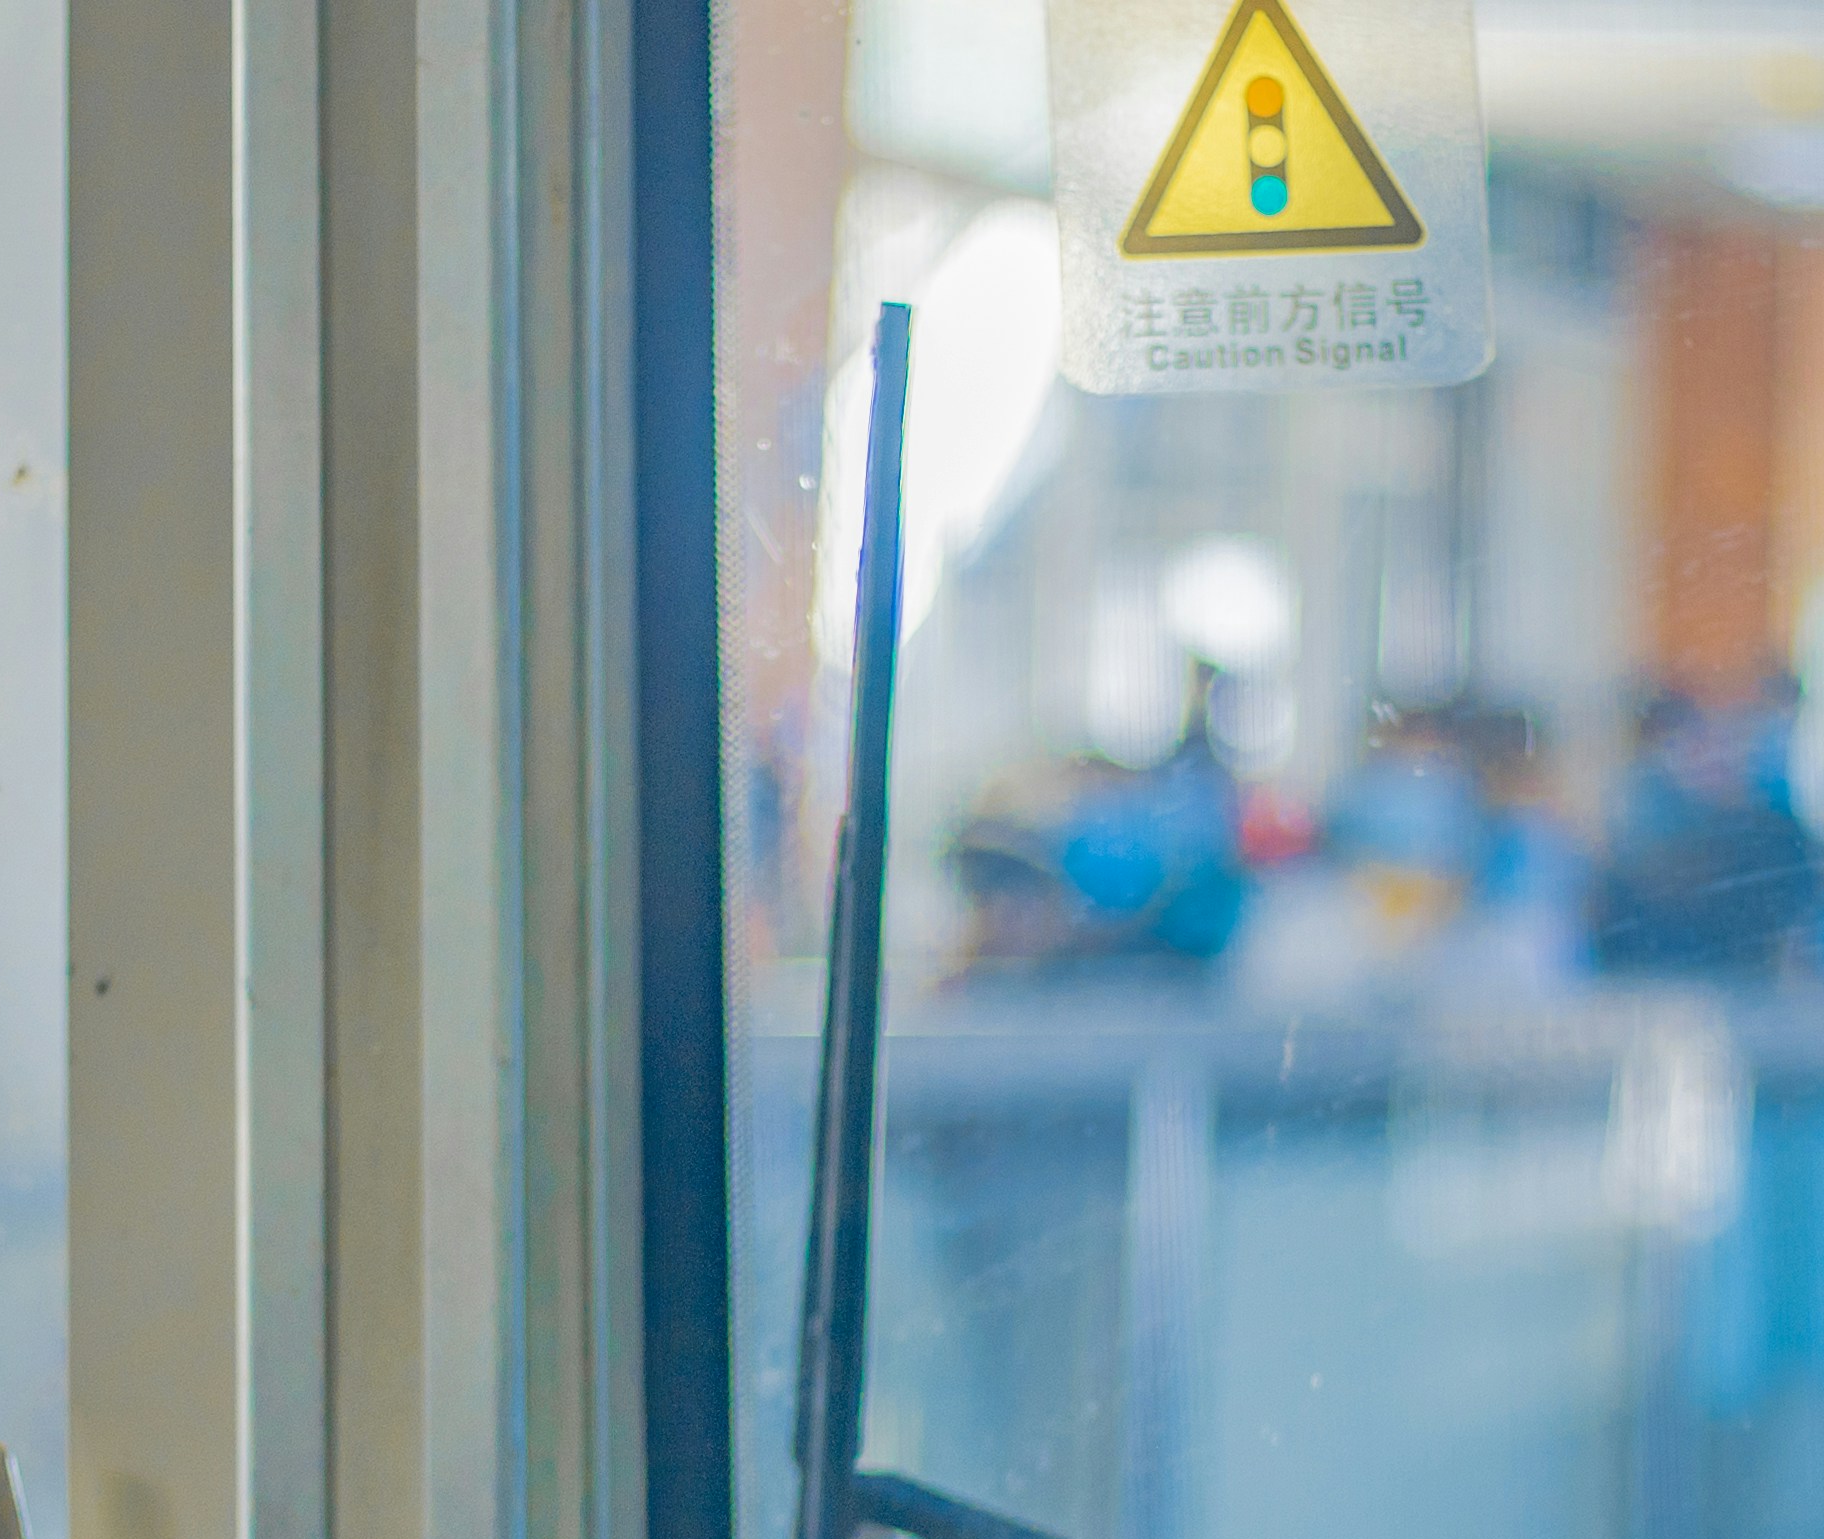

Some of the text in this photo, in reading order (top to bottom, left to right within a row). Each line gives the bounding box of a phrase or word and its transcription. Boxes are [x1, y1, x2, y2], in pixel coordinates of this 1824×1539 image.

[1121, 279, 1431, 338] 注意前方信号
[1147, 335, 1408, 371] Caution Signal
